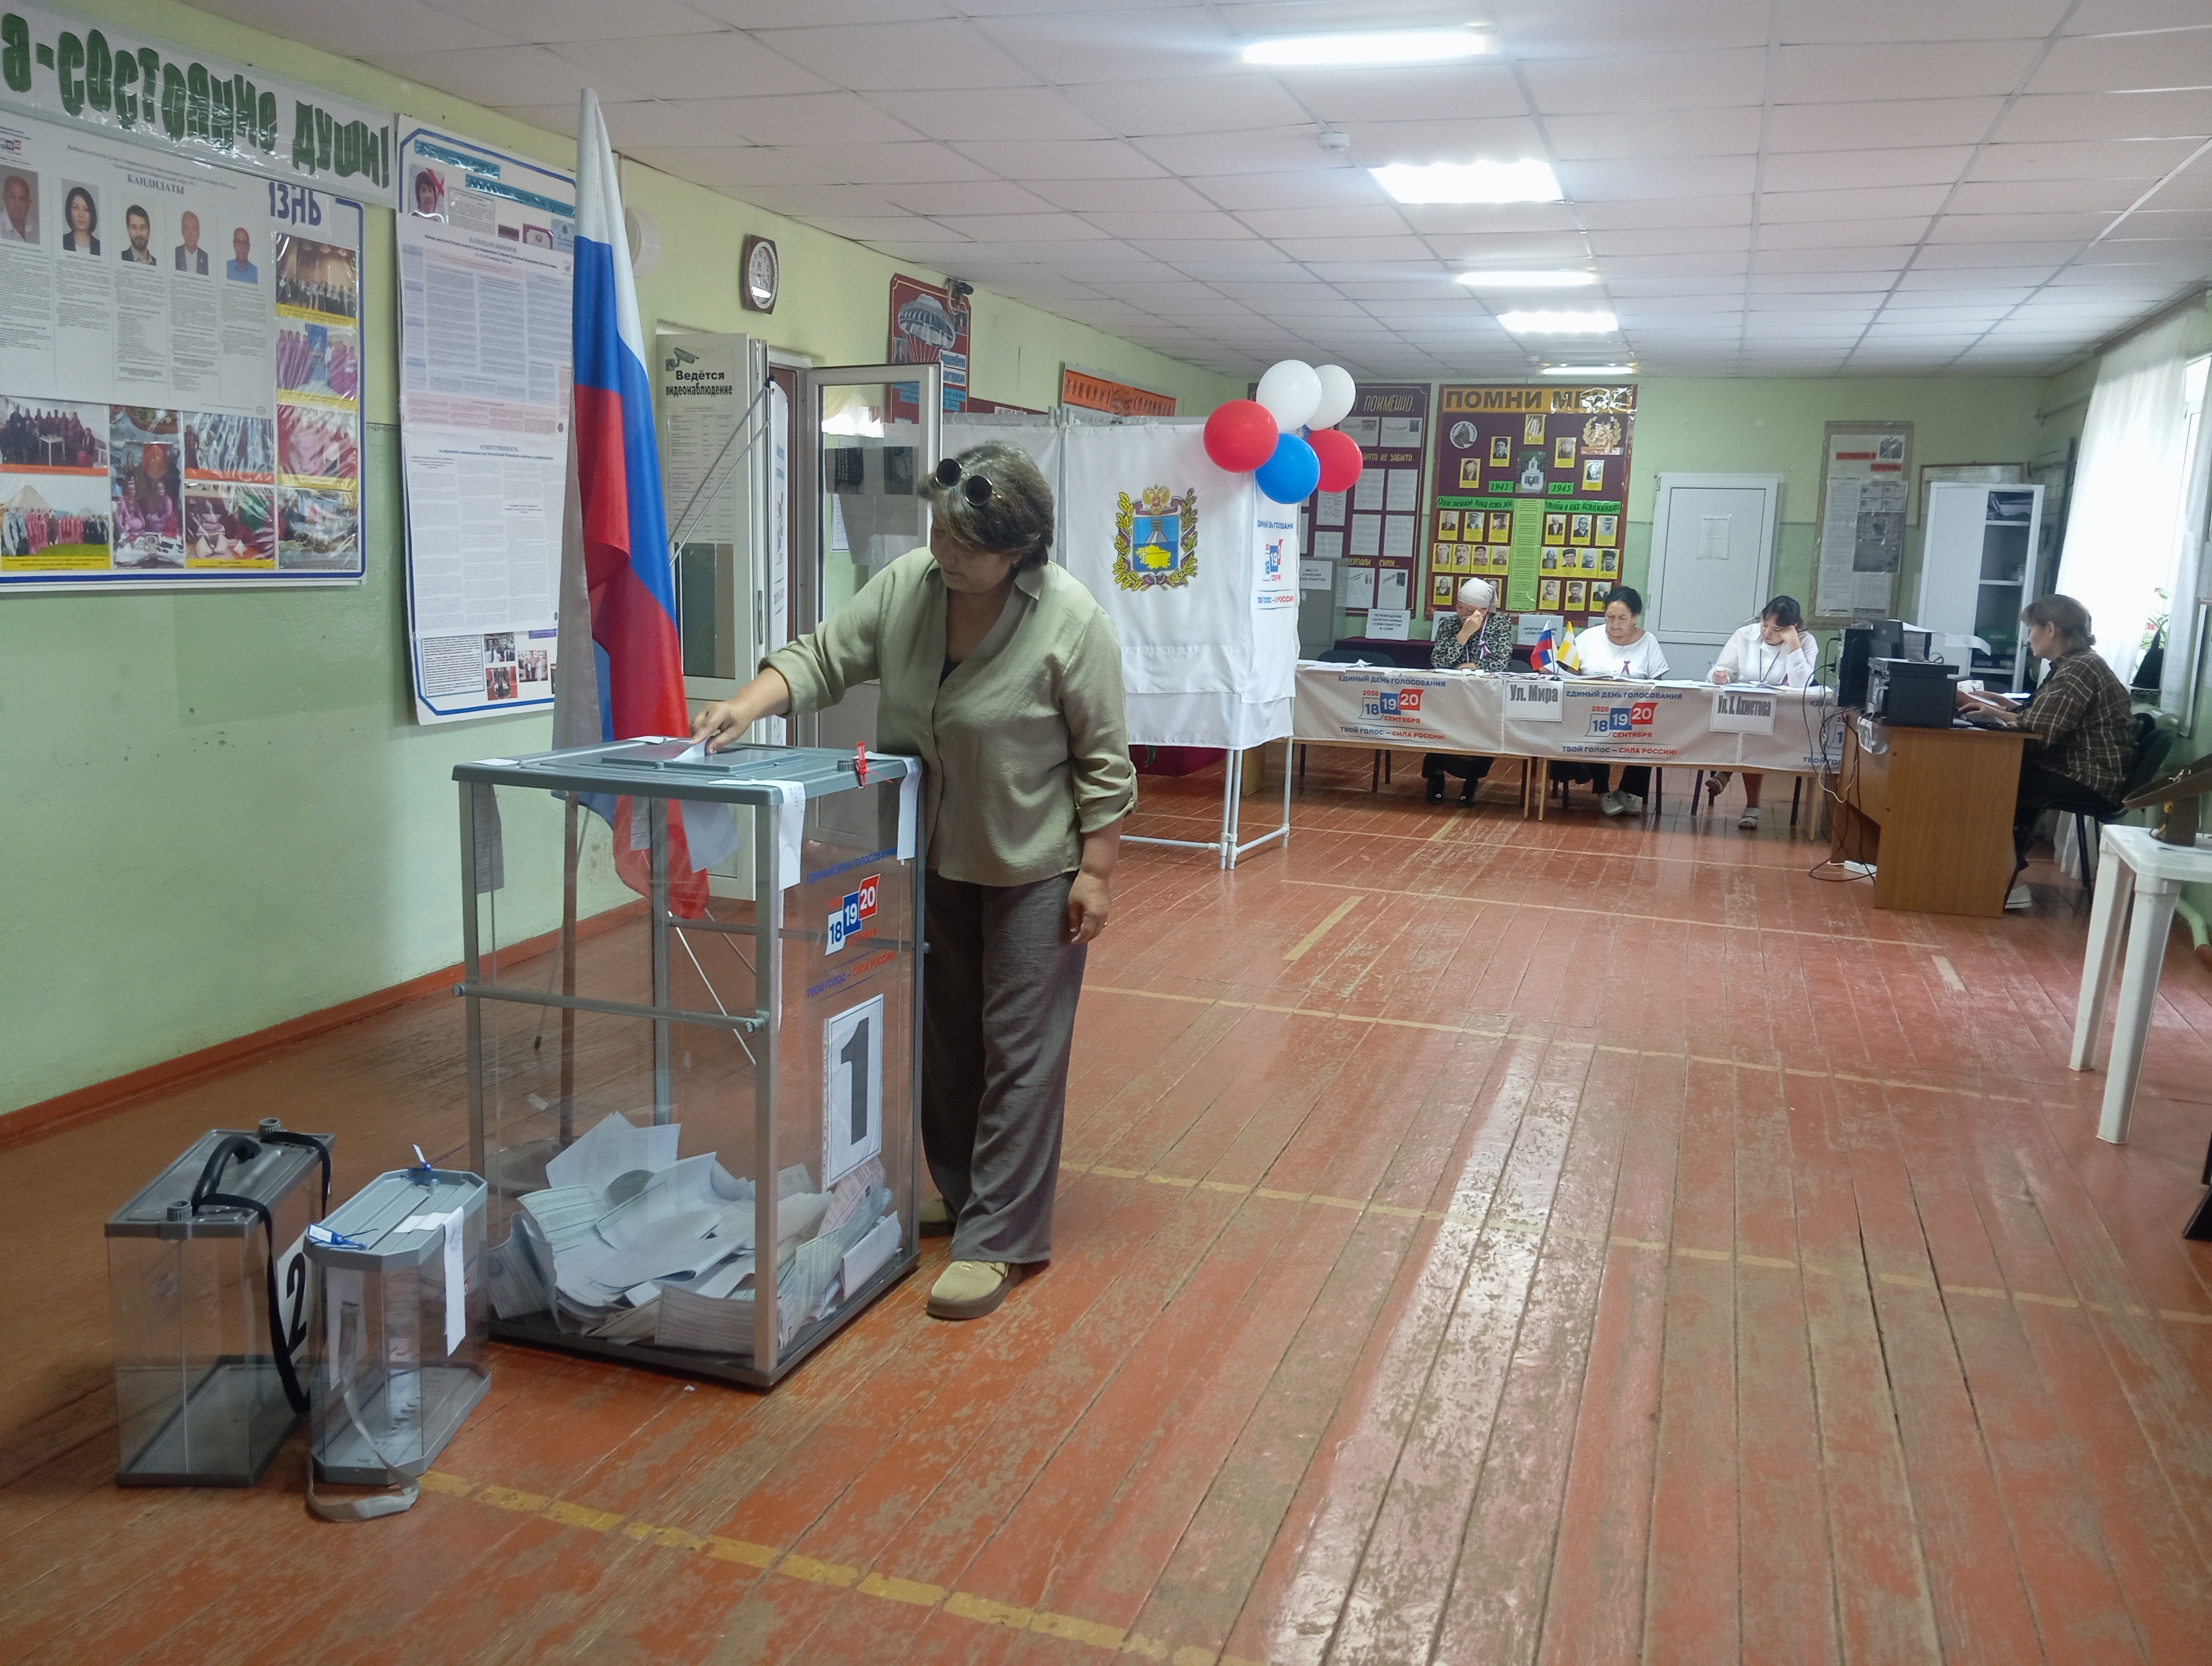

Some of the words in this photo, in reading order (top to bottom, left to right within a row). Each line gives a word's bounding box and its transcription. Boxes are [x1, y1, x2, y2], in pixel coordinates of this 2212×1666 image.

[127, 174, 184, 195] КАНДИДАТЫ
[676, 370, 725, 382] Ведётся
[666, 382, 733, 398] видеонаблюдение
[1445, 390, 1543, 409] ПОМНИ
[1552, 484, 1572, 492] 1945
[1271, 552, 1277, 567] 19
[1391, 678, 1446, 687] ГОЛОСОВАНИЯ
[1400, 694, 1419, 706] 20
[1510, 684, 1526, 702] Ул.
[1528, 685, 1558, 703] Мира
[1365, 703, 1380, 715] 18
[1381, 698, 1397, 710] 19
[1718, 695, 1728, 714] Ул.
[1384, 715, 1420, 724] СЕНТЯБРЯ
[1612, 713, 1629, 726] 19
[1631, 708, 1652, 720] 20
[1593, 720, 1608, 732] 18
[807, 863, 835, 884] ЕДИНЫЙ
[835, 862, 852, 874] ДЕНЬ
[860, 886, 876, 911] 20
[845, 903, 858, 927] 19
[829, 921, 842, 945] 18
[807, 982, 825, 998] ТВОЙ
[825, 973, 846, 989] ГОЛОС
[853, 963, 869, 977] СИЛА
[870, 951, 895, 969] РОССИИ!
[841, 1017, 869, 1145] 1
[286, 1252, 307, 1356] 2
